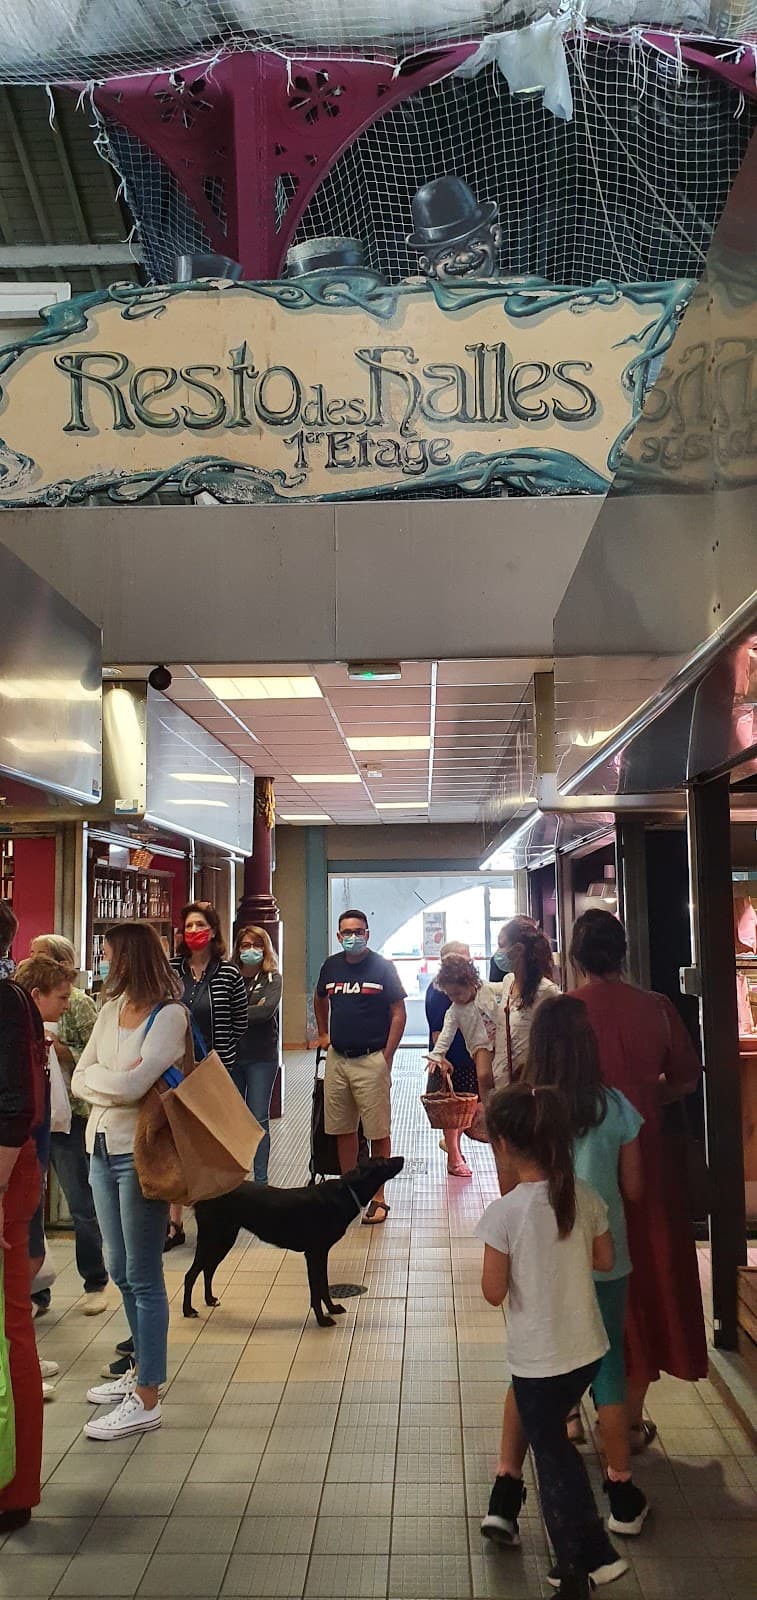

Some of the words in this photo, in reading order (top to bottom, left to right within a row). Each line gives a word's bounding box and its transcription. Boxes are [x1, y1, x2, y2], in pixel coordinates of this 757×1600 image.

[54, 340, 301, 431] Resto
[300, 384, 367, 426] des
[284, 428, 323, 468] 1er
[325, 430, 451, 474] Etage
[334, 982, 361, 994] FILA
